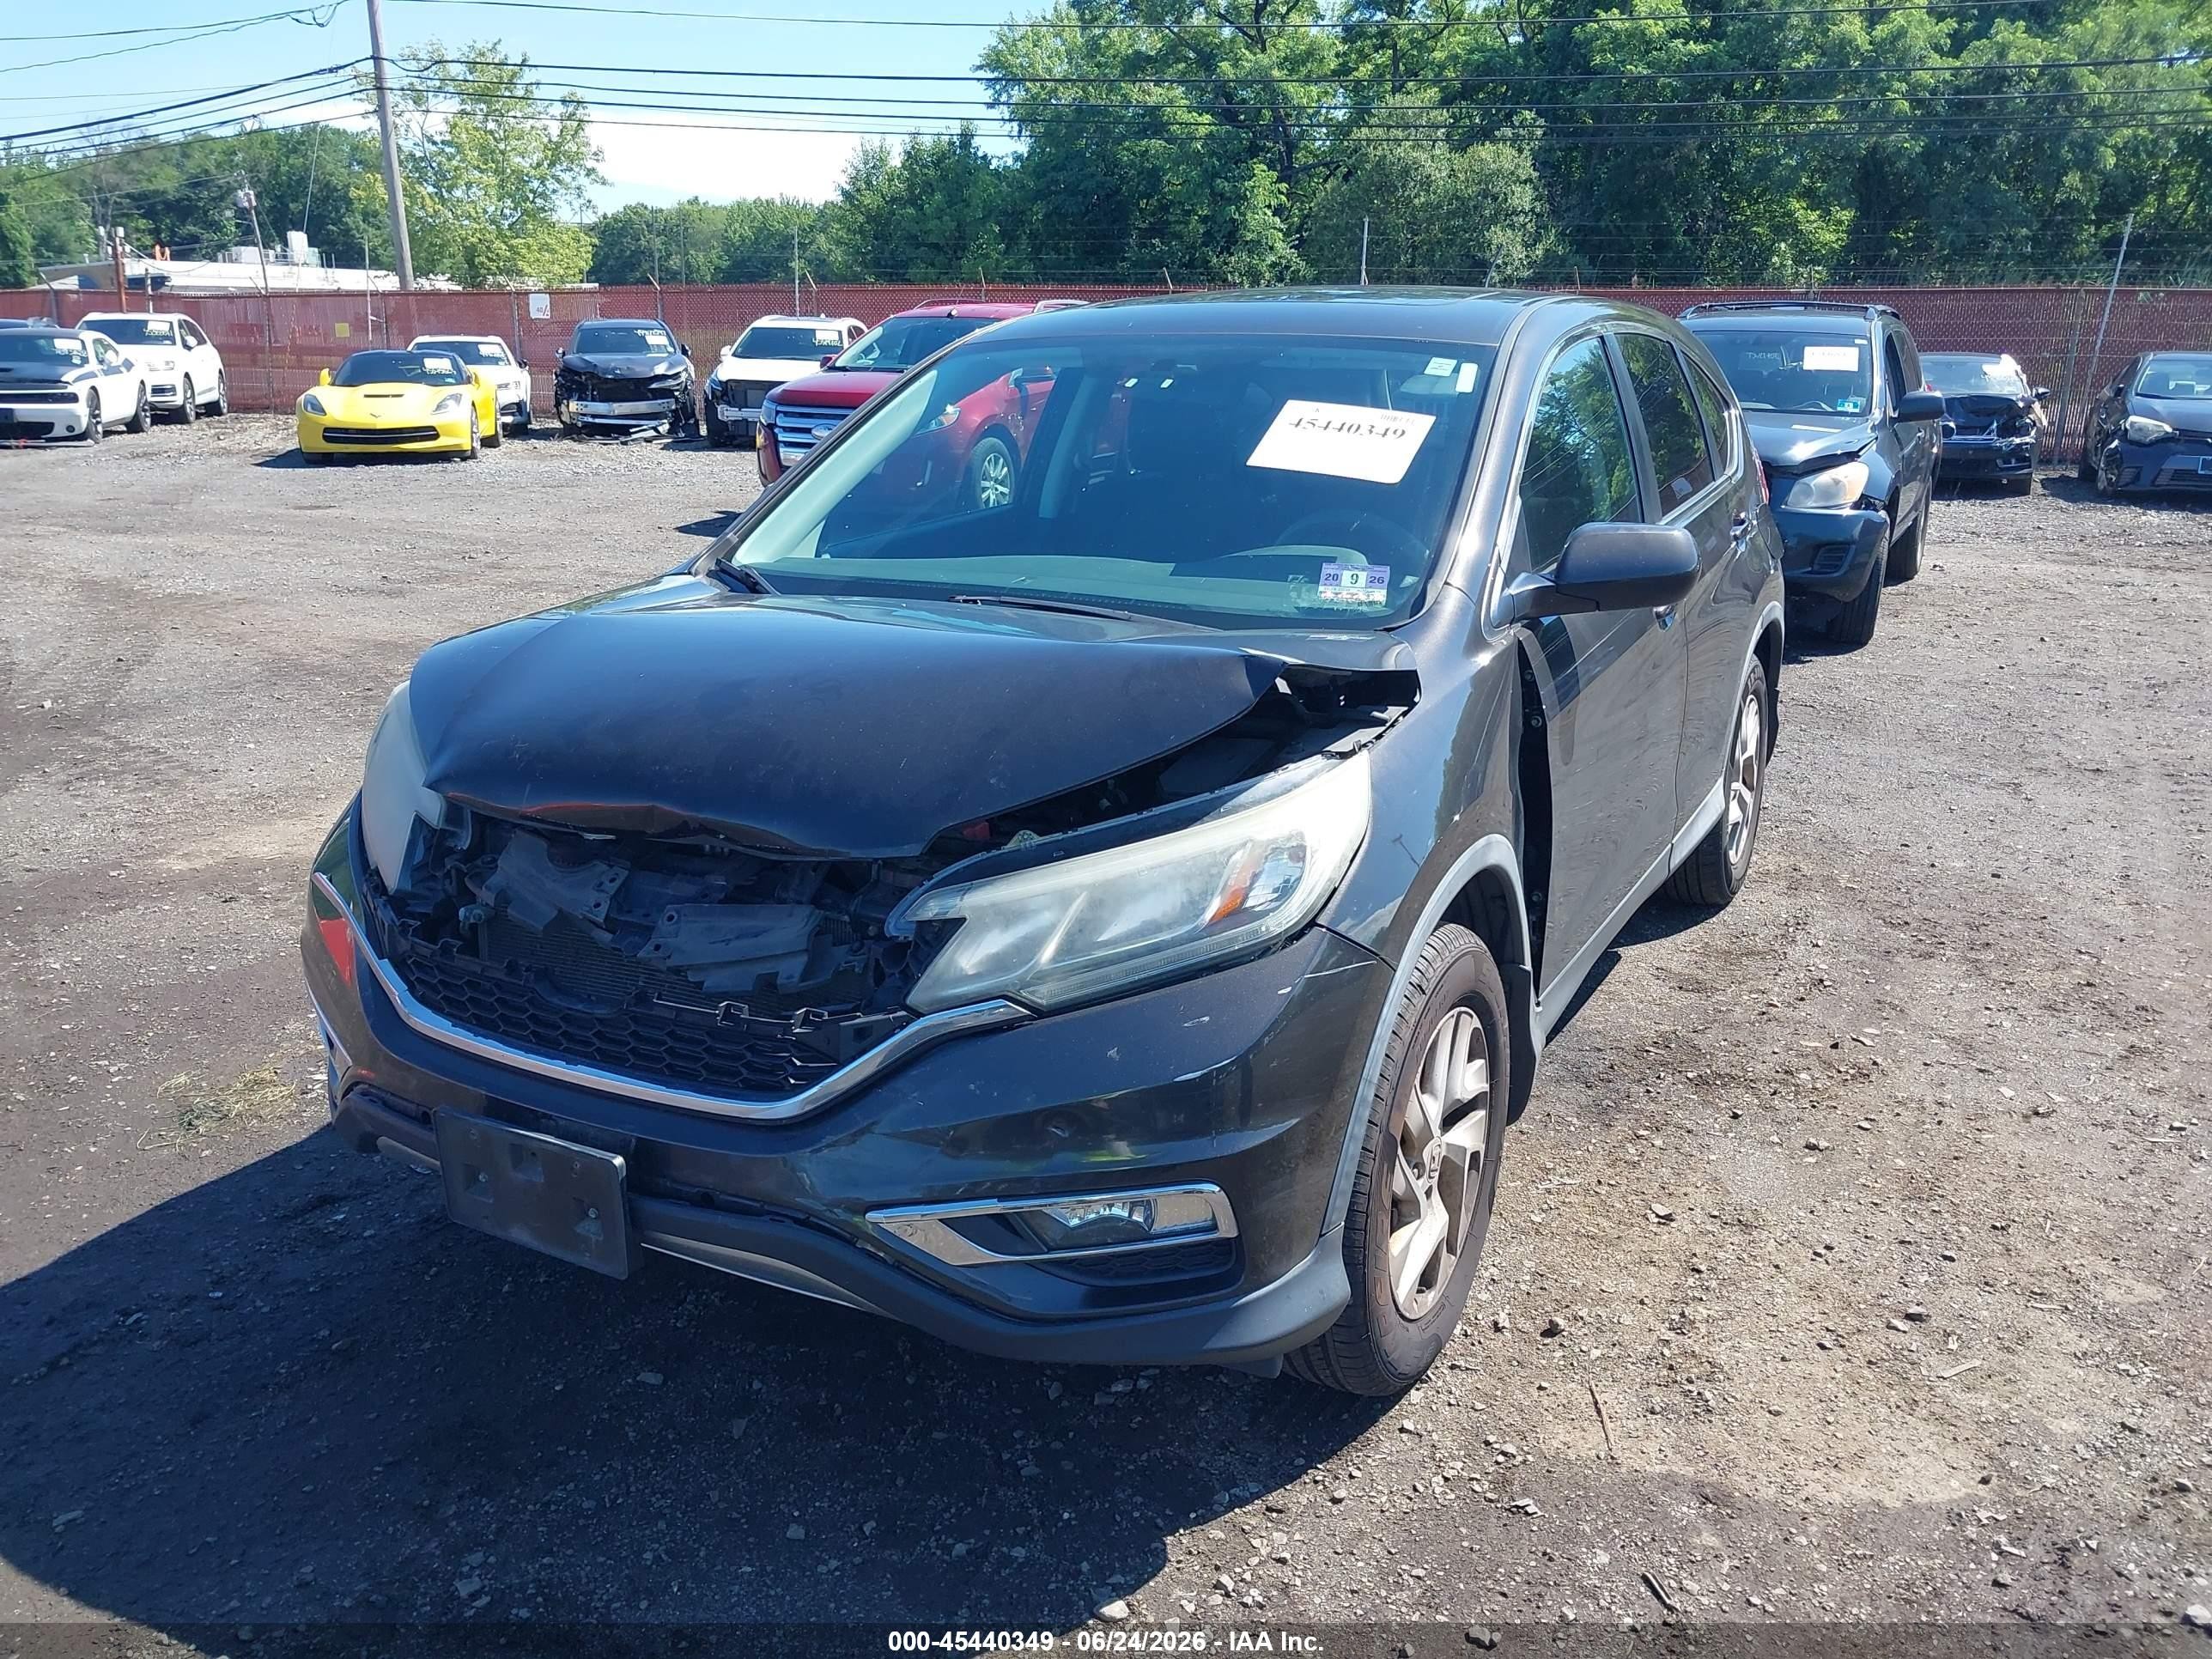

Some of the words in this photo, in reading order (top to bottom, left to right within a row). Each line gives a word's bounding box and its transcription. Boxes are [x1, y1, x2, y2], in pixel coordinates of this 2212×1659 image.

[1289, 417, 1407, 439] 45440349
[1324, 573, 1340, 582] 20
[1350, 573, 1359, 585] 9
[1369, 575, 1385, 584] 26
